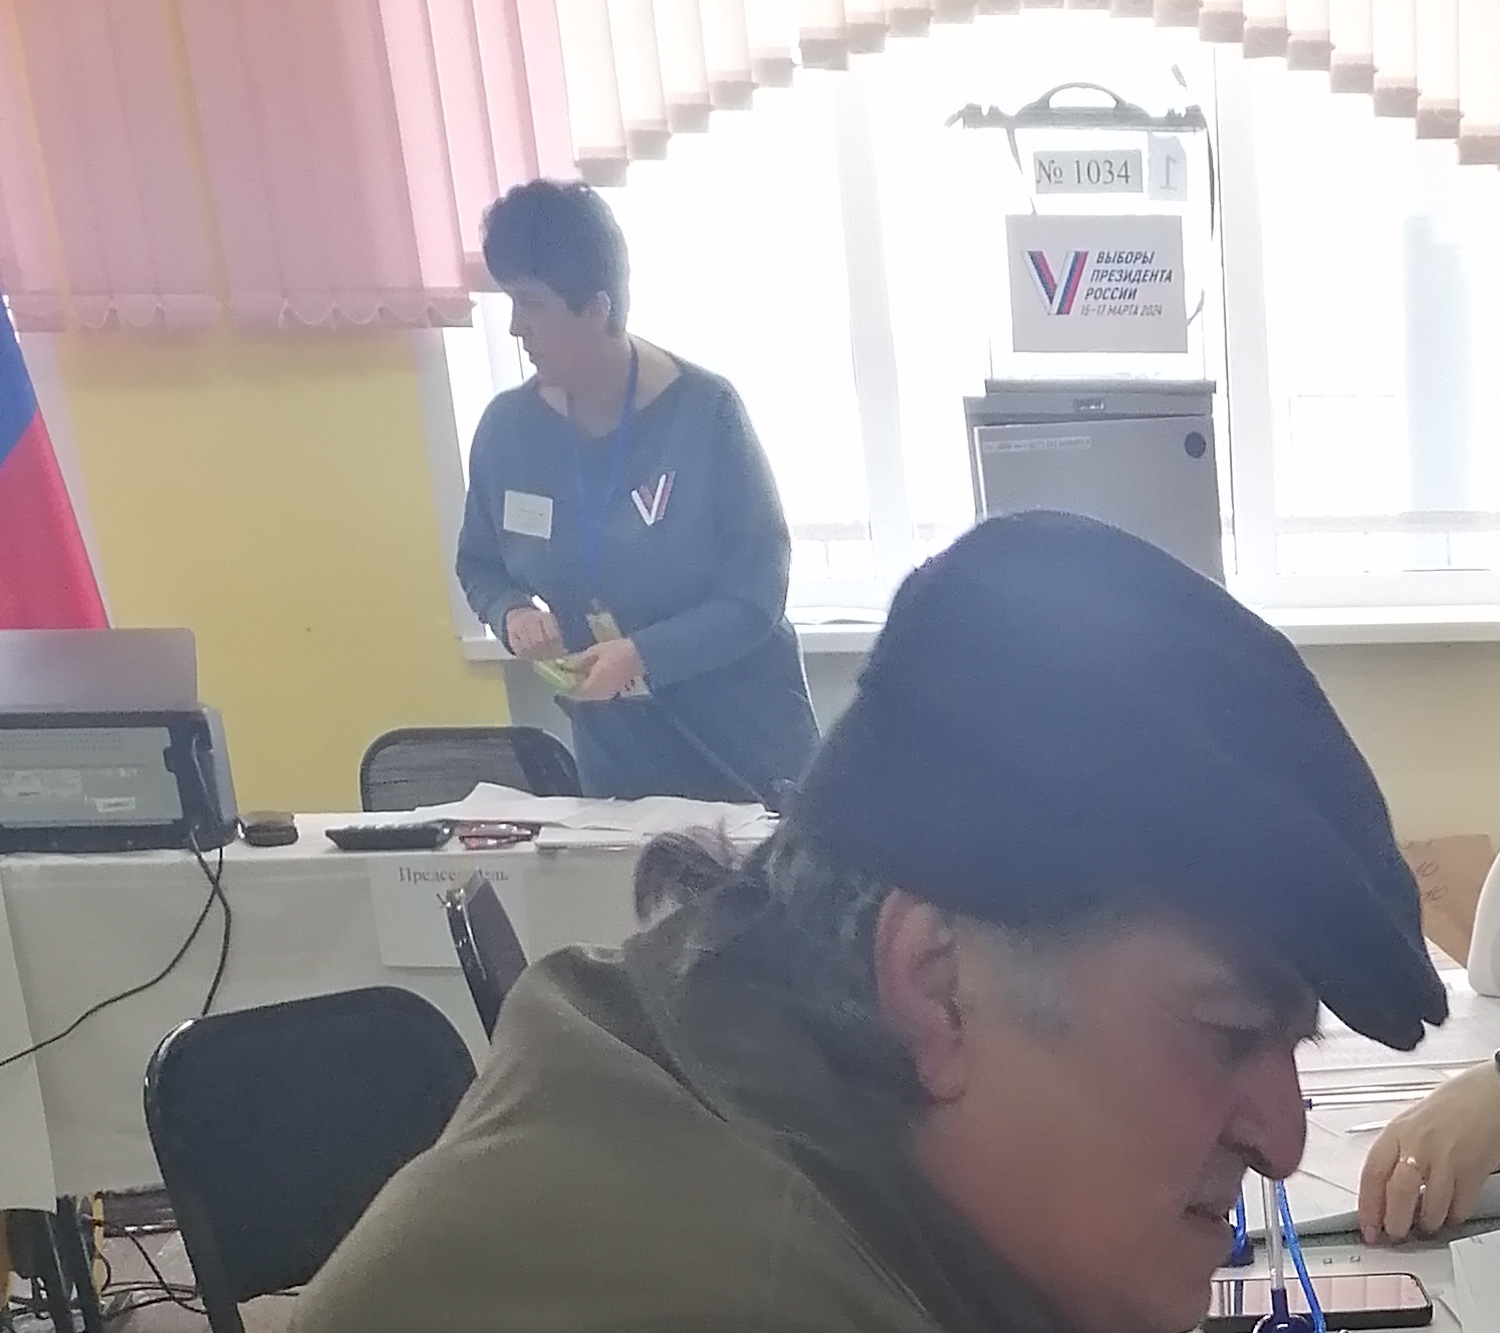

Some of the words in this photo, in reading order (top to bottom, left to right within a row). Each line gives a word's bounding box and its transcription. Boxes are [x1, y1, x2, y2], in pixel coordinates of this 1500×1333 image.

[1035, 160, 1063, 184] №
[1074, 160, 1132, 184] 1034
[1095, 250, 1155, 265] ВЫБОРЫ
[1089, 269, 1173, 283] ПРЕЗИДЕНТА
[1084, 287, 1138, 301] РОССИИ
[1108, 304, 1139, 316] МАРТА
[1140, 304, 1163, 316] 2024
